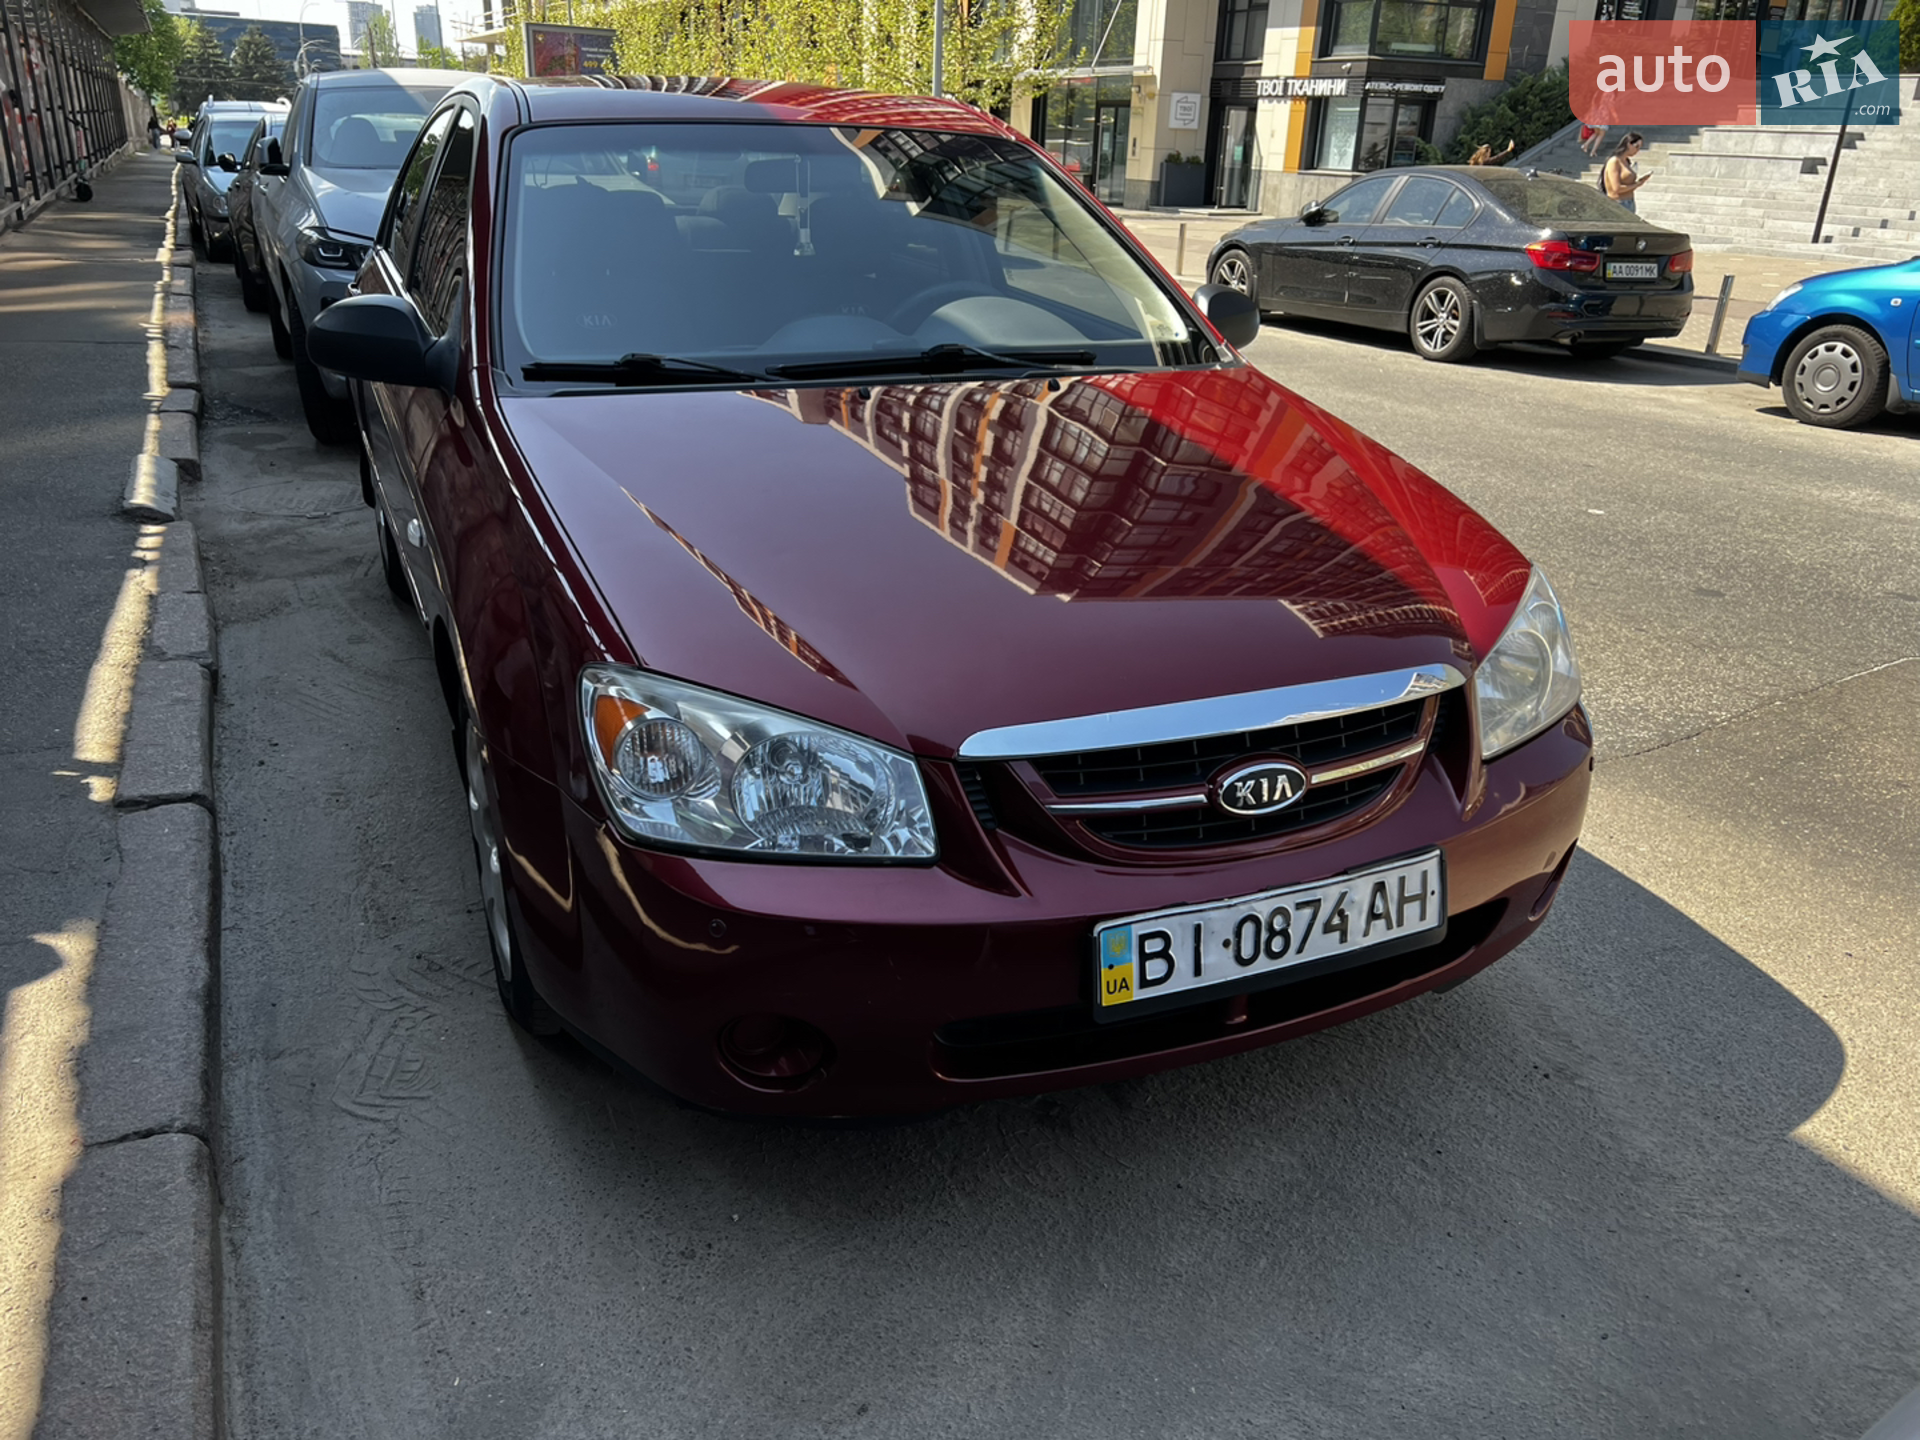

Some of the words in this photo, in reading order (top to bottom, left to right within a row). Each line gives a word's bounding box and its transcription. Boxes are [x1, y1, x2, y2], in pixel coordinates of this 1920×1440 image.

[1256, 77, 1285, 96] ТВОЇ
[1286, 79, 1347, 96] ТКАНИНИ
[583, 315, 612, 326] KIA
[1234, 774, 1293, 808] KIA
[1138, 922, 1203, 989] BI
[1233, 889, 1350, 967] 0874
[1362, 869, 1429, 938] AH
[1106, 976, 1131, 995] UA
